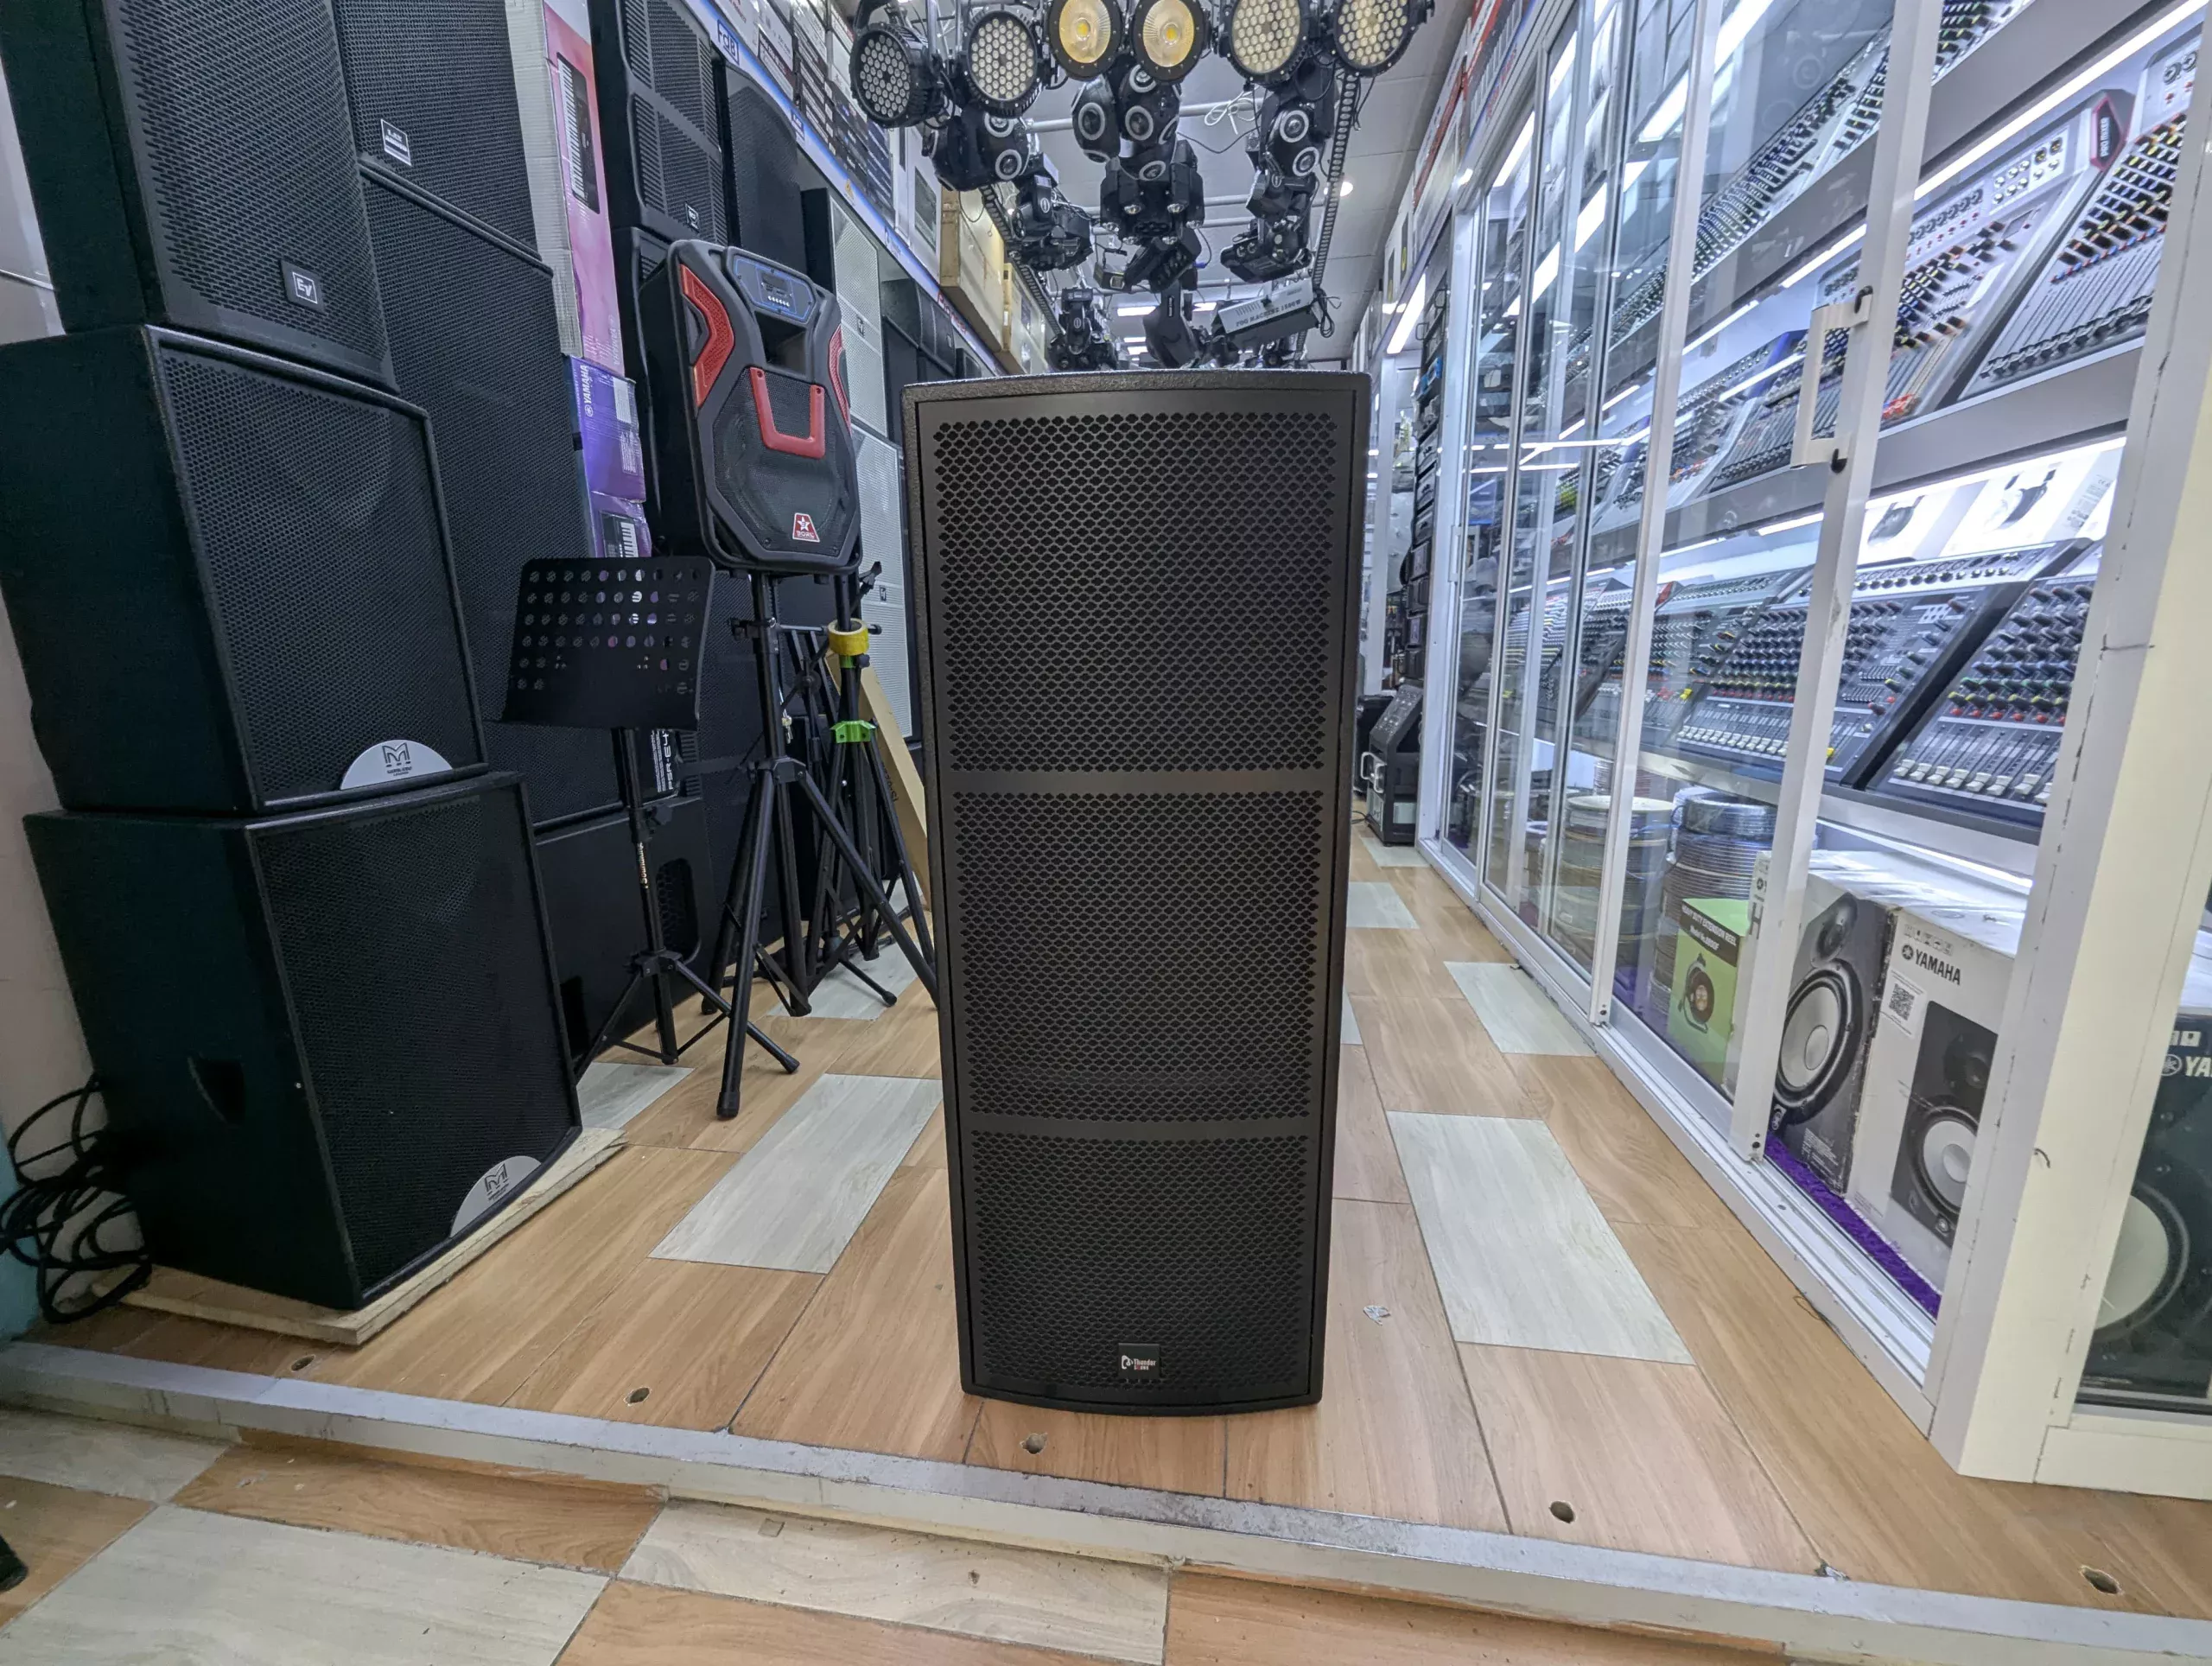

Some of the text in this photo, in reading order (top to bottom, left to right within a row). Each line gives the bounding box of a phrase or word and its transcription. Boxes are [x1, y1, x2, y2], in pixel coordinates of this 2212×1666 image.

[296, 277, 312, 296] EV
[580, 364, 593, 404] YAMAHA
[661, 730, 674, 791] PSR-E4
[1915, 949, 1961, 986] YAMAHA
[2185, 1056, 2212, 1078] YA
